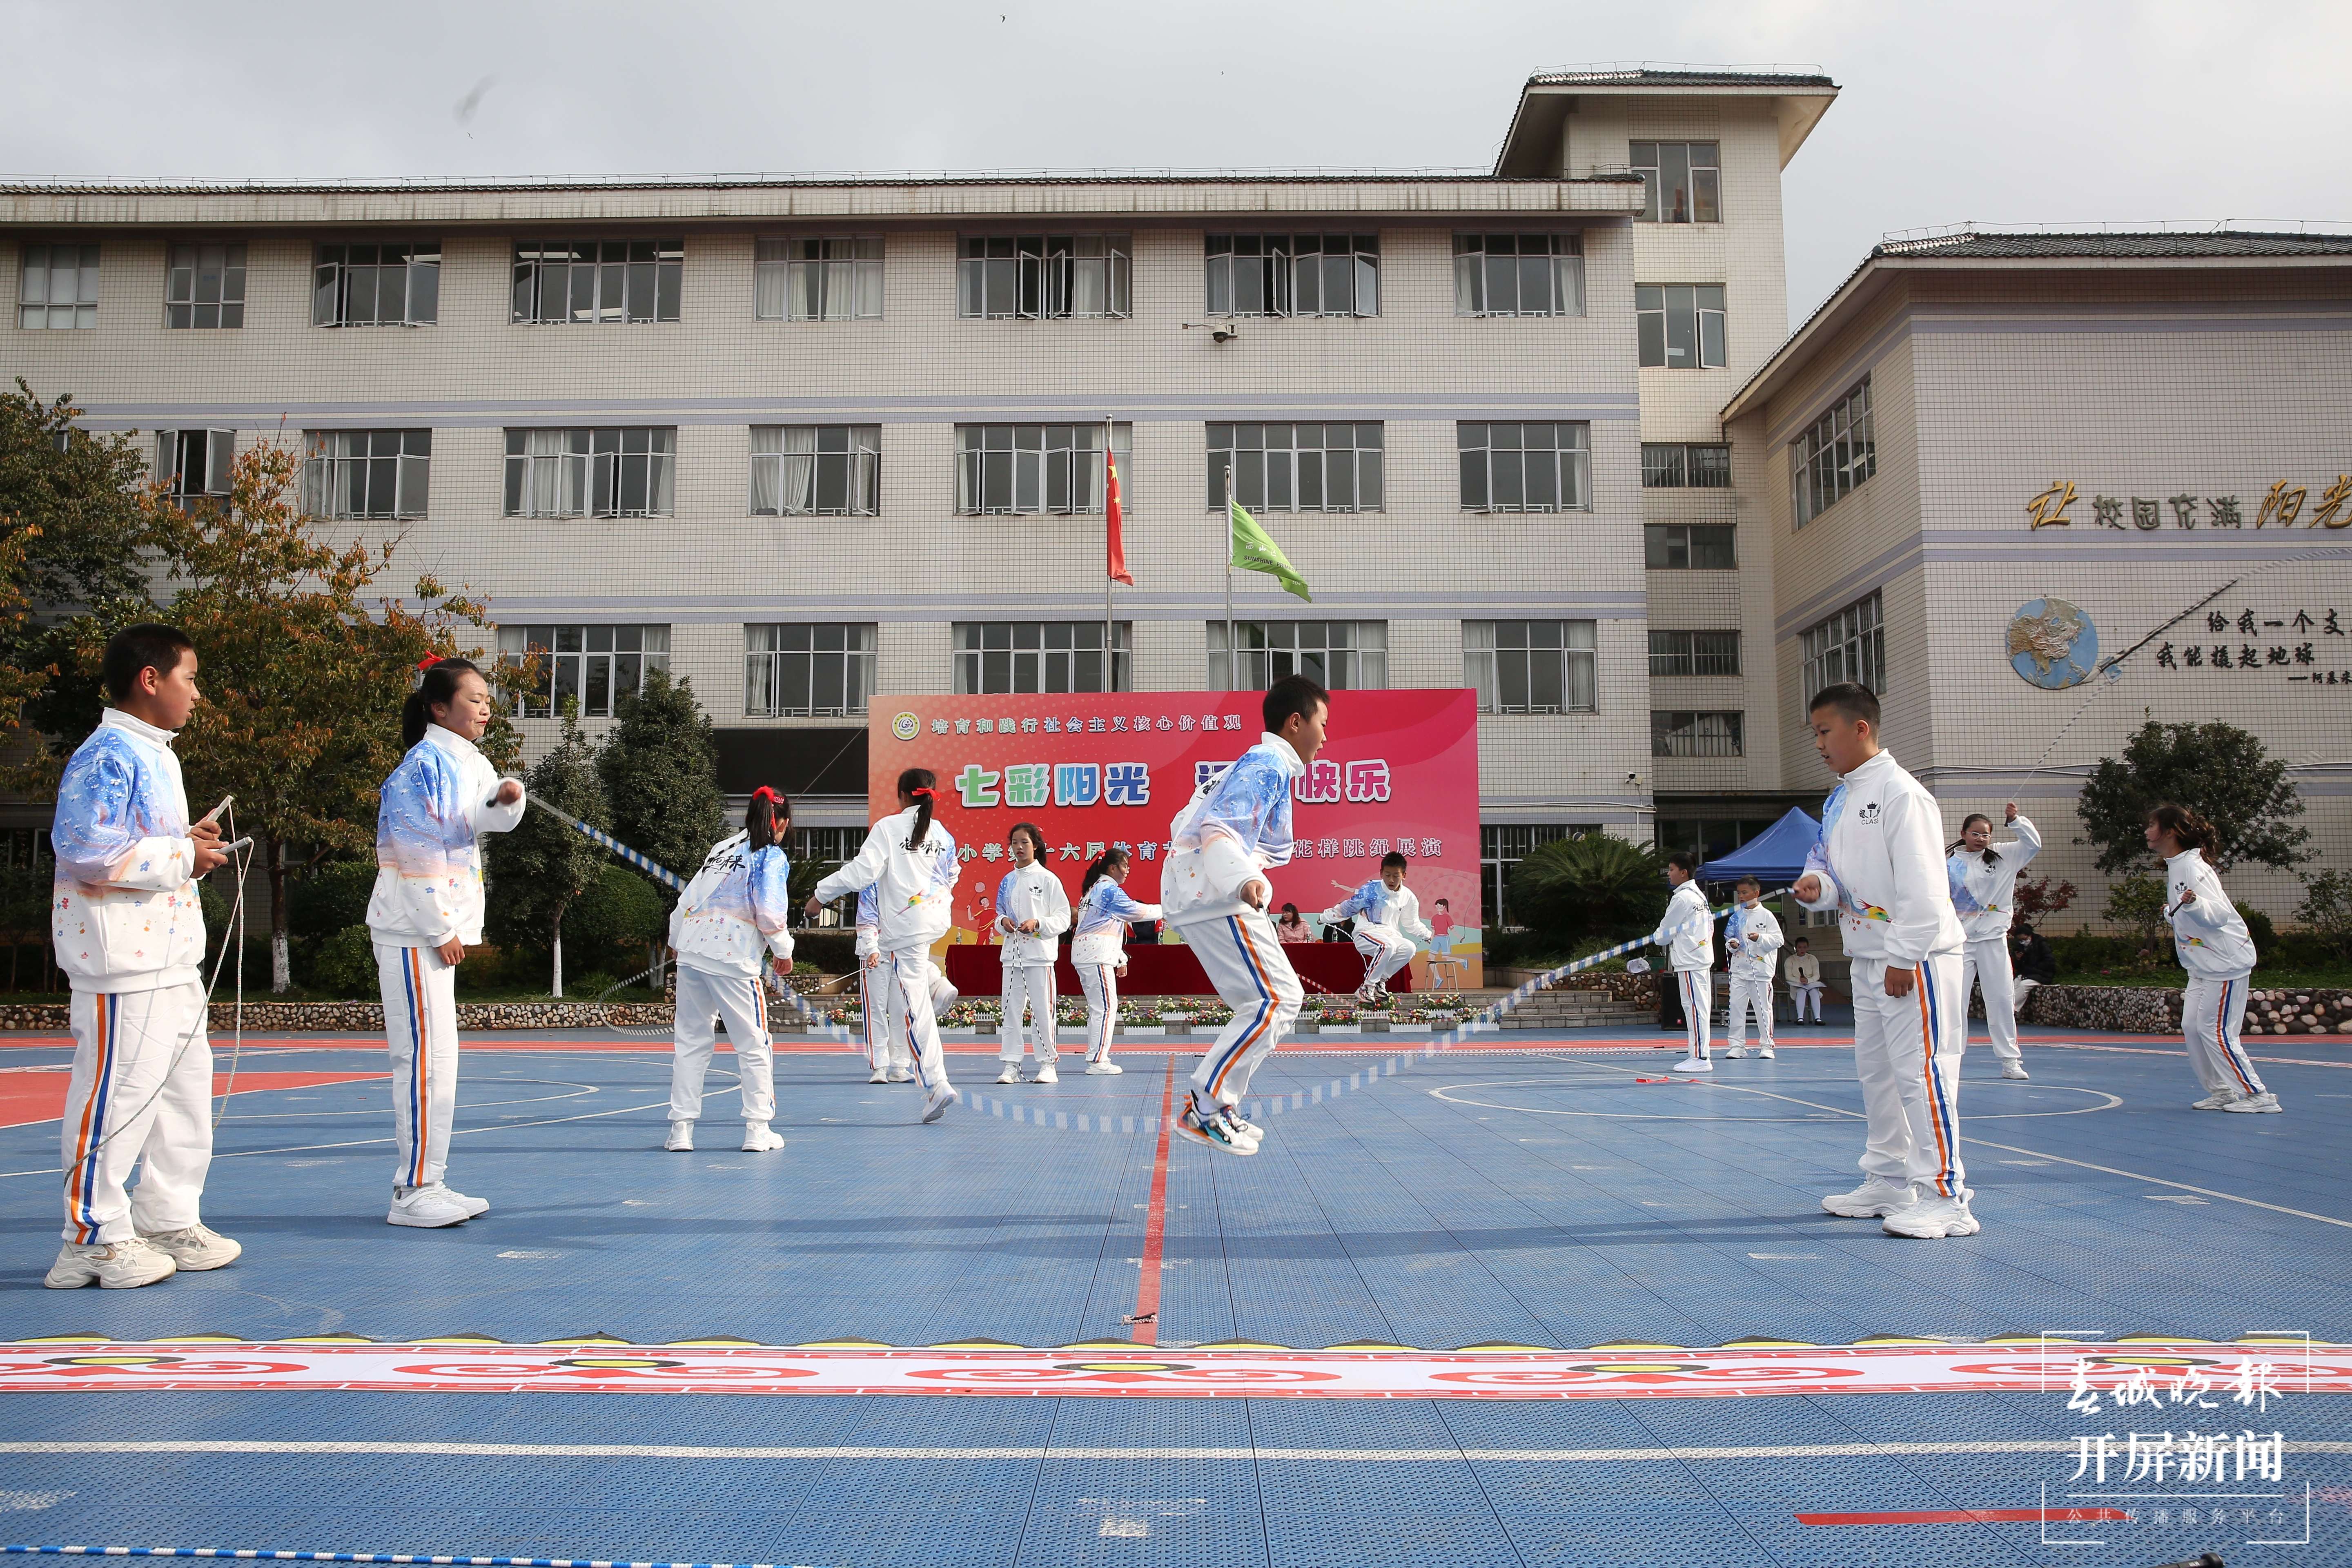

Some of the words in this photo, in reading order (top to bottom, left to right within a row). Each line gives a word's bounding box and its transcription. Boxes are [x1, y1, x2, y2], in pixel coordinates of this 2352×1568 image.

[1244, 555, 1273, 565] SUNSHINE
[2207, 608, 2352, 637] 给我一个支
[2157, 641, 2315, 670] 我能撬起地球
[931, 715, 1241, 734] 培育和践行社会主义核心价值观
[955, 762, 1150, 807] 七彩阳光
[1195, 759, 1392, 803] 快乐
